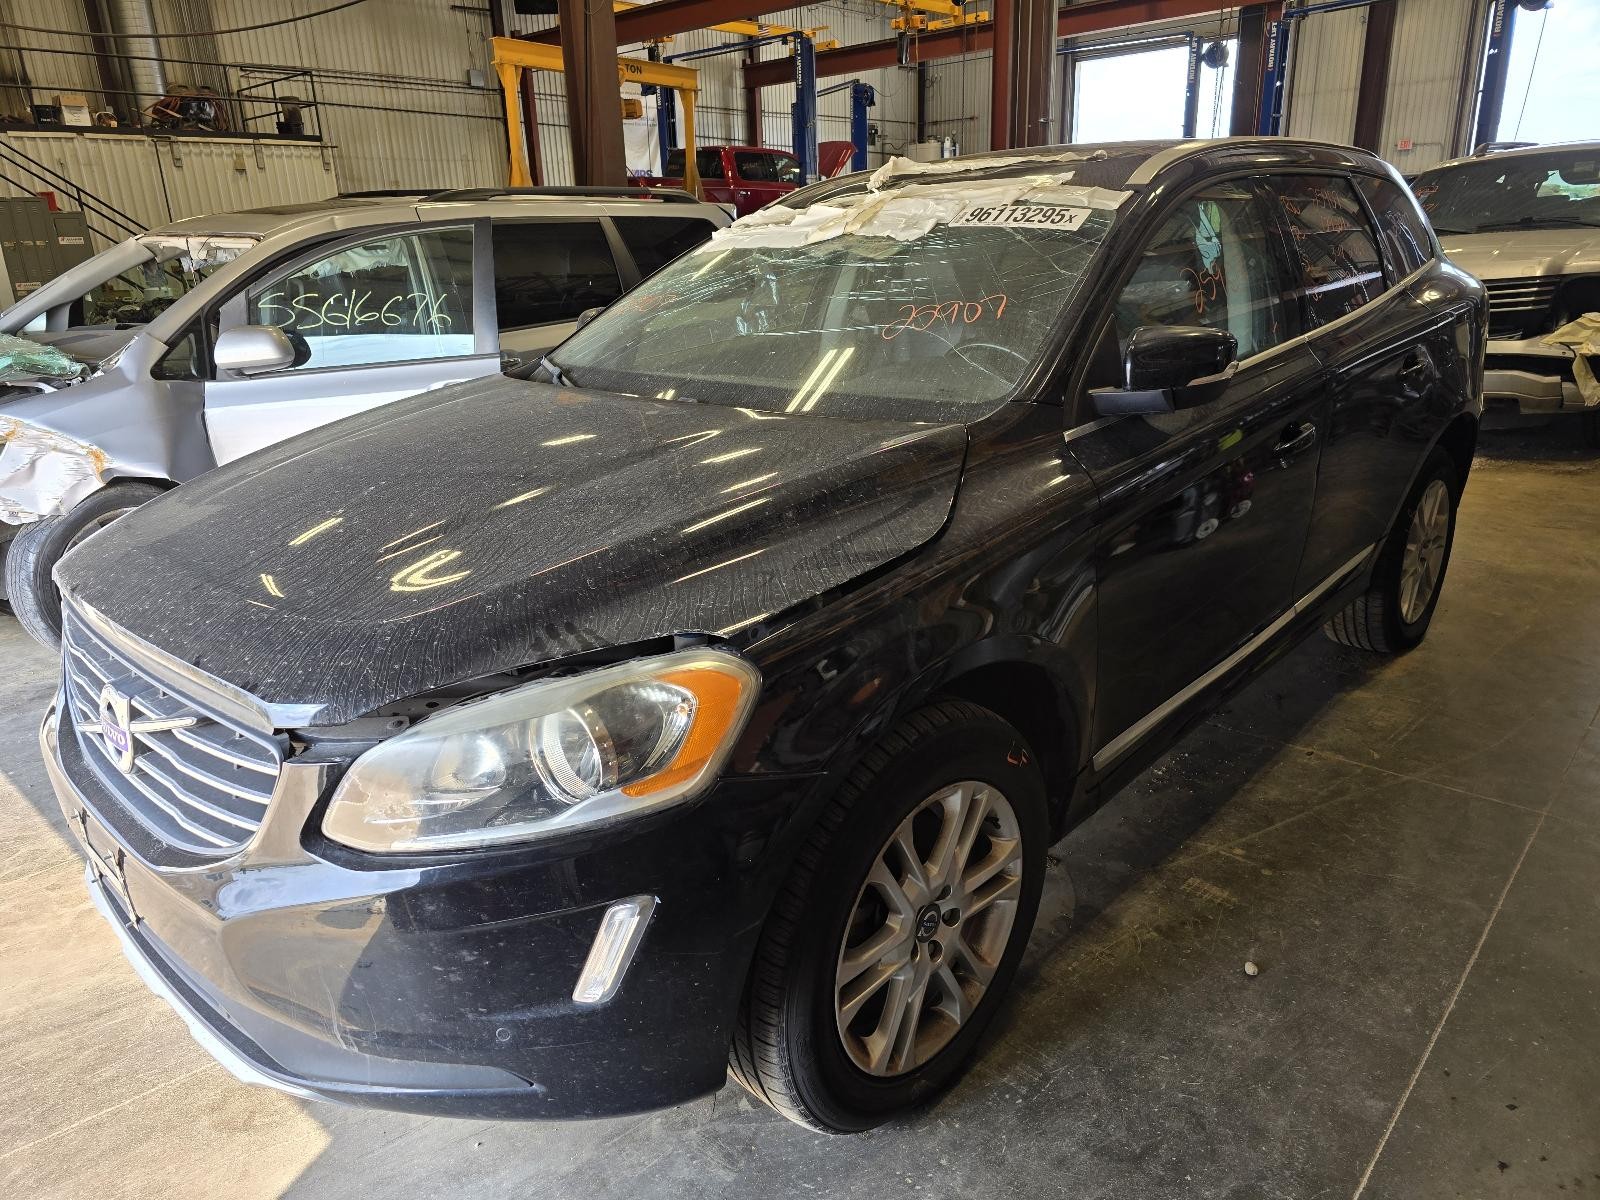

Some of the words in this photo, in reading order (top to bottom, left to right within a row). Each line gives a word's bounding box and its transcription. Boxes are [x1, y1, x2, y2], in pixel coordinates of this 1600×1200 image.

[1270, 22, 1278, 37] LIFT
[1267, 38, 1276, 68] ROTARY
[624, 63, 642, 75] TON
[1189, 53, 1197, 80] ROTARY
